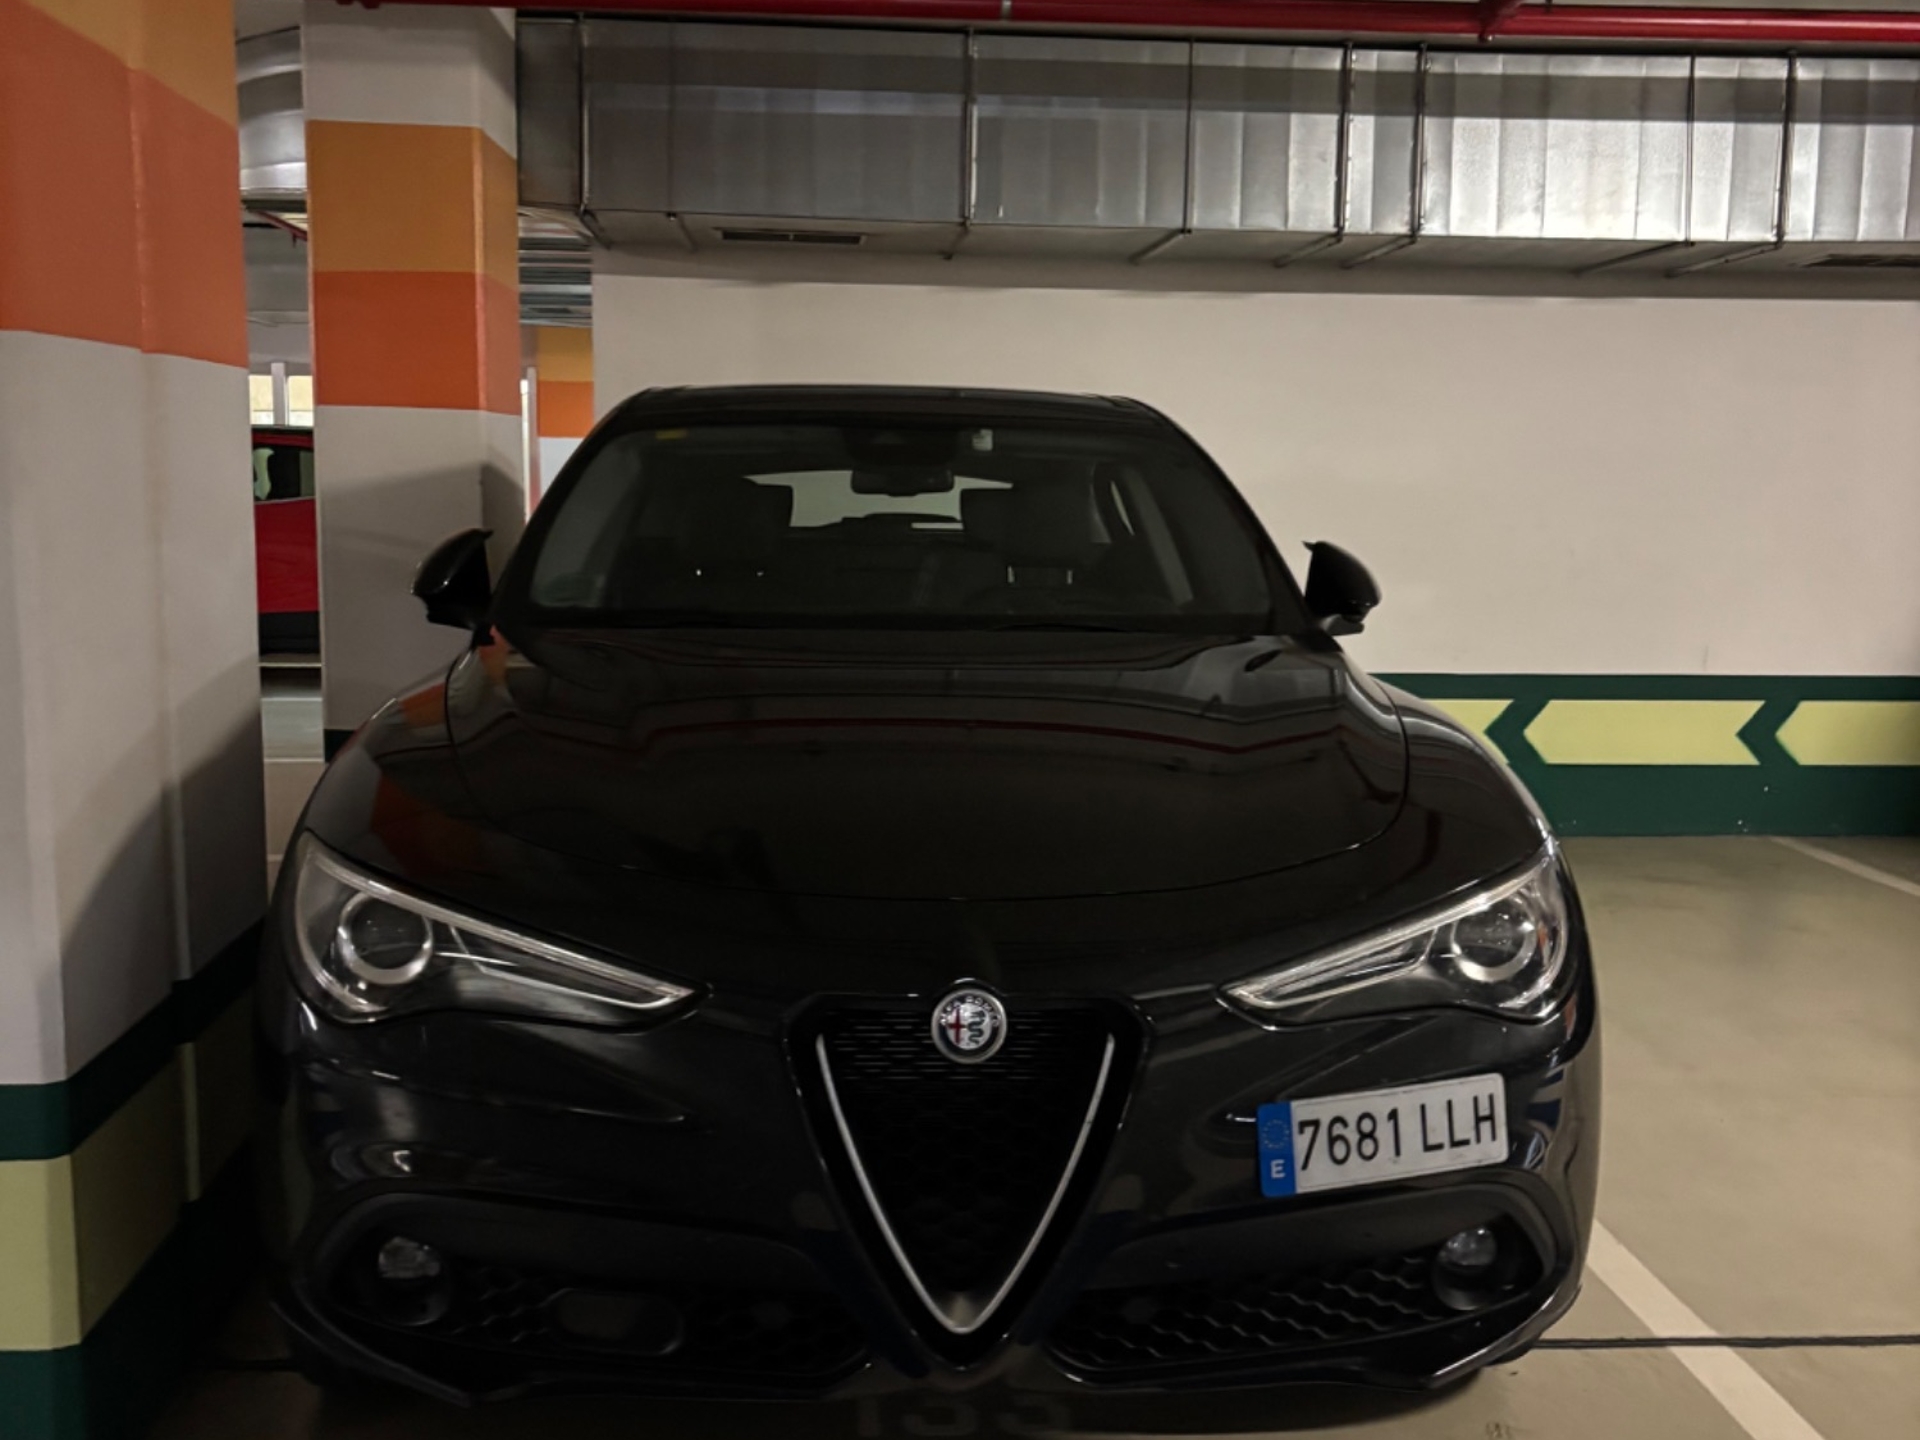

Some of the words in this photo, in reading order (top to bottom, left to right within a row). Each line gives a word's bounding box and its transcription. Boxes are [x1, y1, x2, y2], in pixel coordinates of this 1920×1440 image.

[1298, 1108, 1401, 1170] 7681
[1420, 1093, 1496, 1152] LLH
[1269, 1159, 1286, 1179] E
